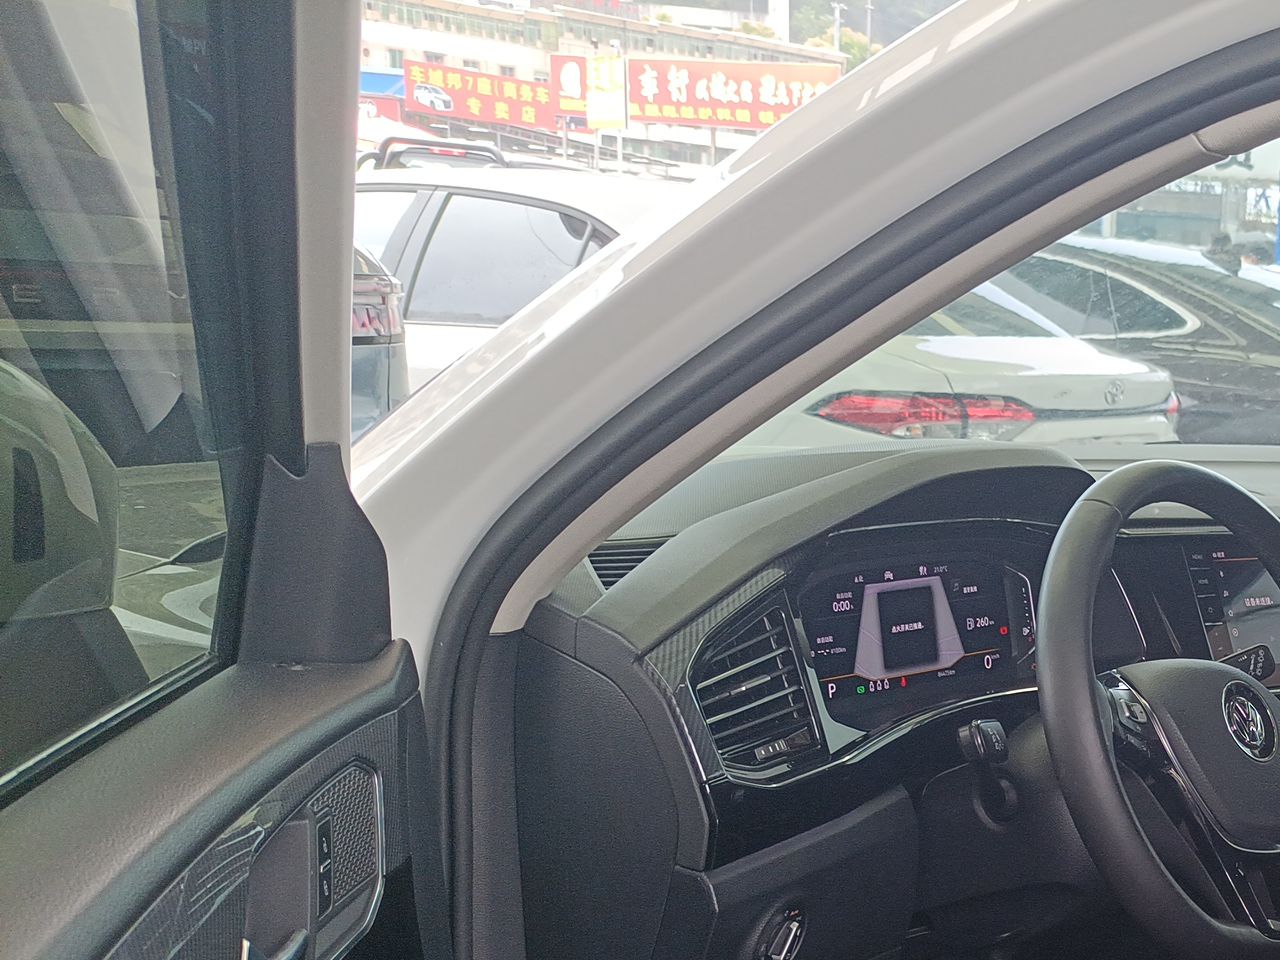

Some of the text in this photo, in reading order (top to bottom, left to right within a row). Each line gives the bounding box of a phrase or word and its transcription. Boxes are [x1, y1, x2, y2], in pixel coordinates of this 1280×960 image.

[832, 601, 851, 612] 0:00
[976, 616, 989, 627] 260
[828, 683, 837, 698] P
